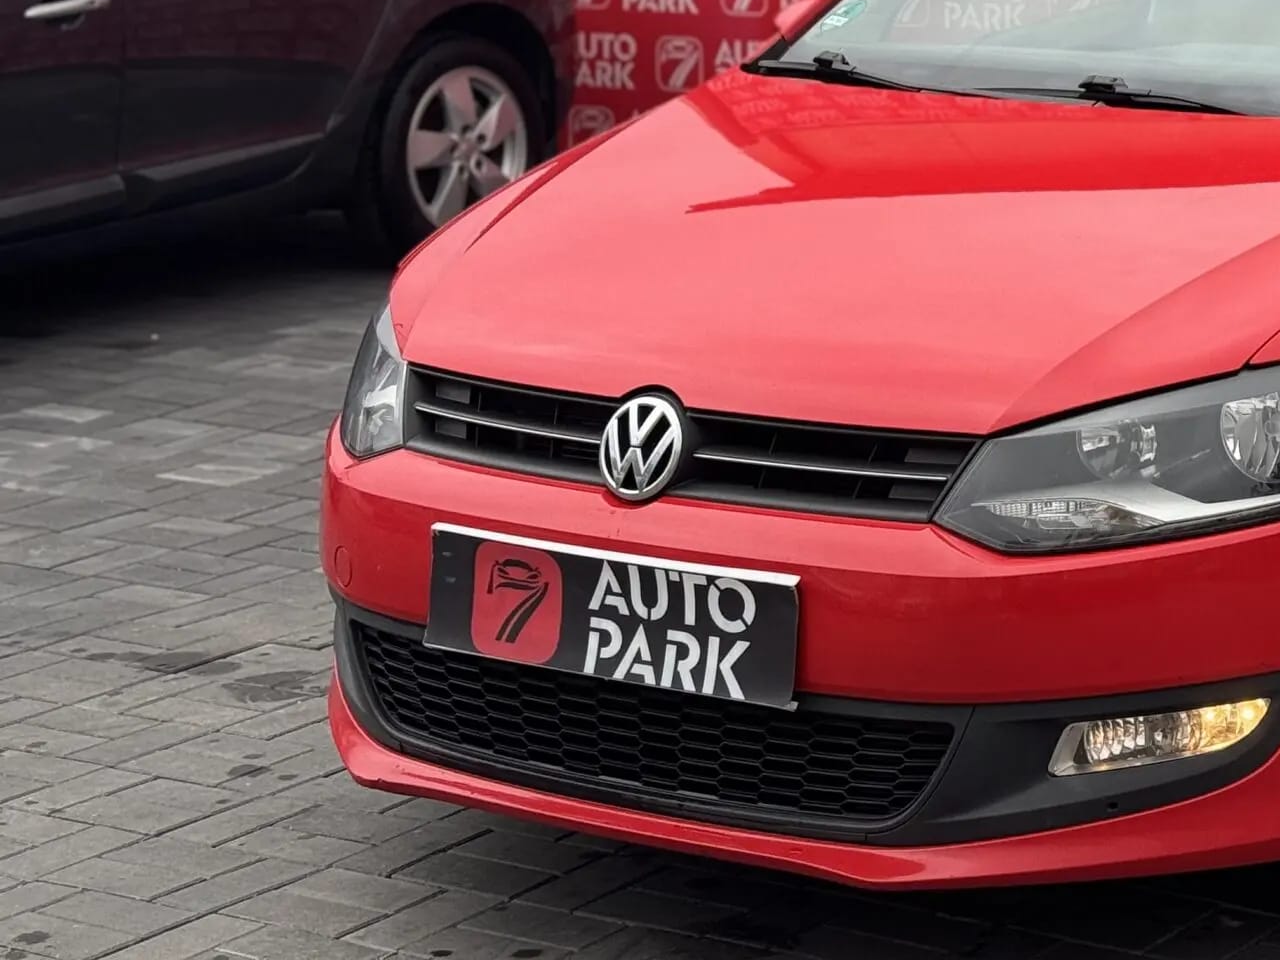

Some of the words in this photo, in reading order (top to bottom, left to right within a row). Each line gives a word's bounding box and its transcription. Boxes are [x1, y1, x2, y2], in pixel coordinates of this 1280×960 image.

[943, 0, 1027, 30] PARK
[588, 559, 756, 634] AUTO
[583, 617, 752, 700] PARK
